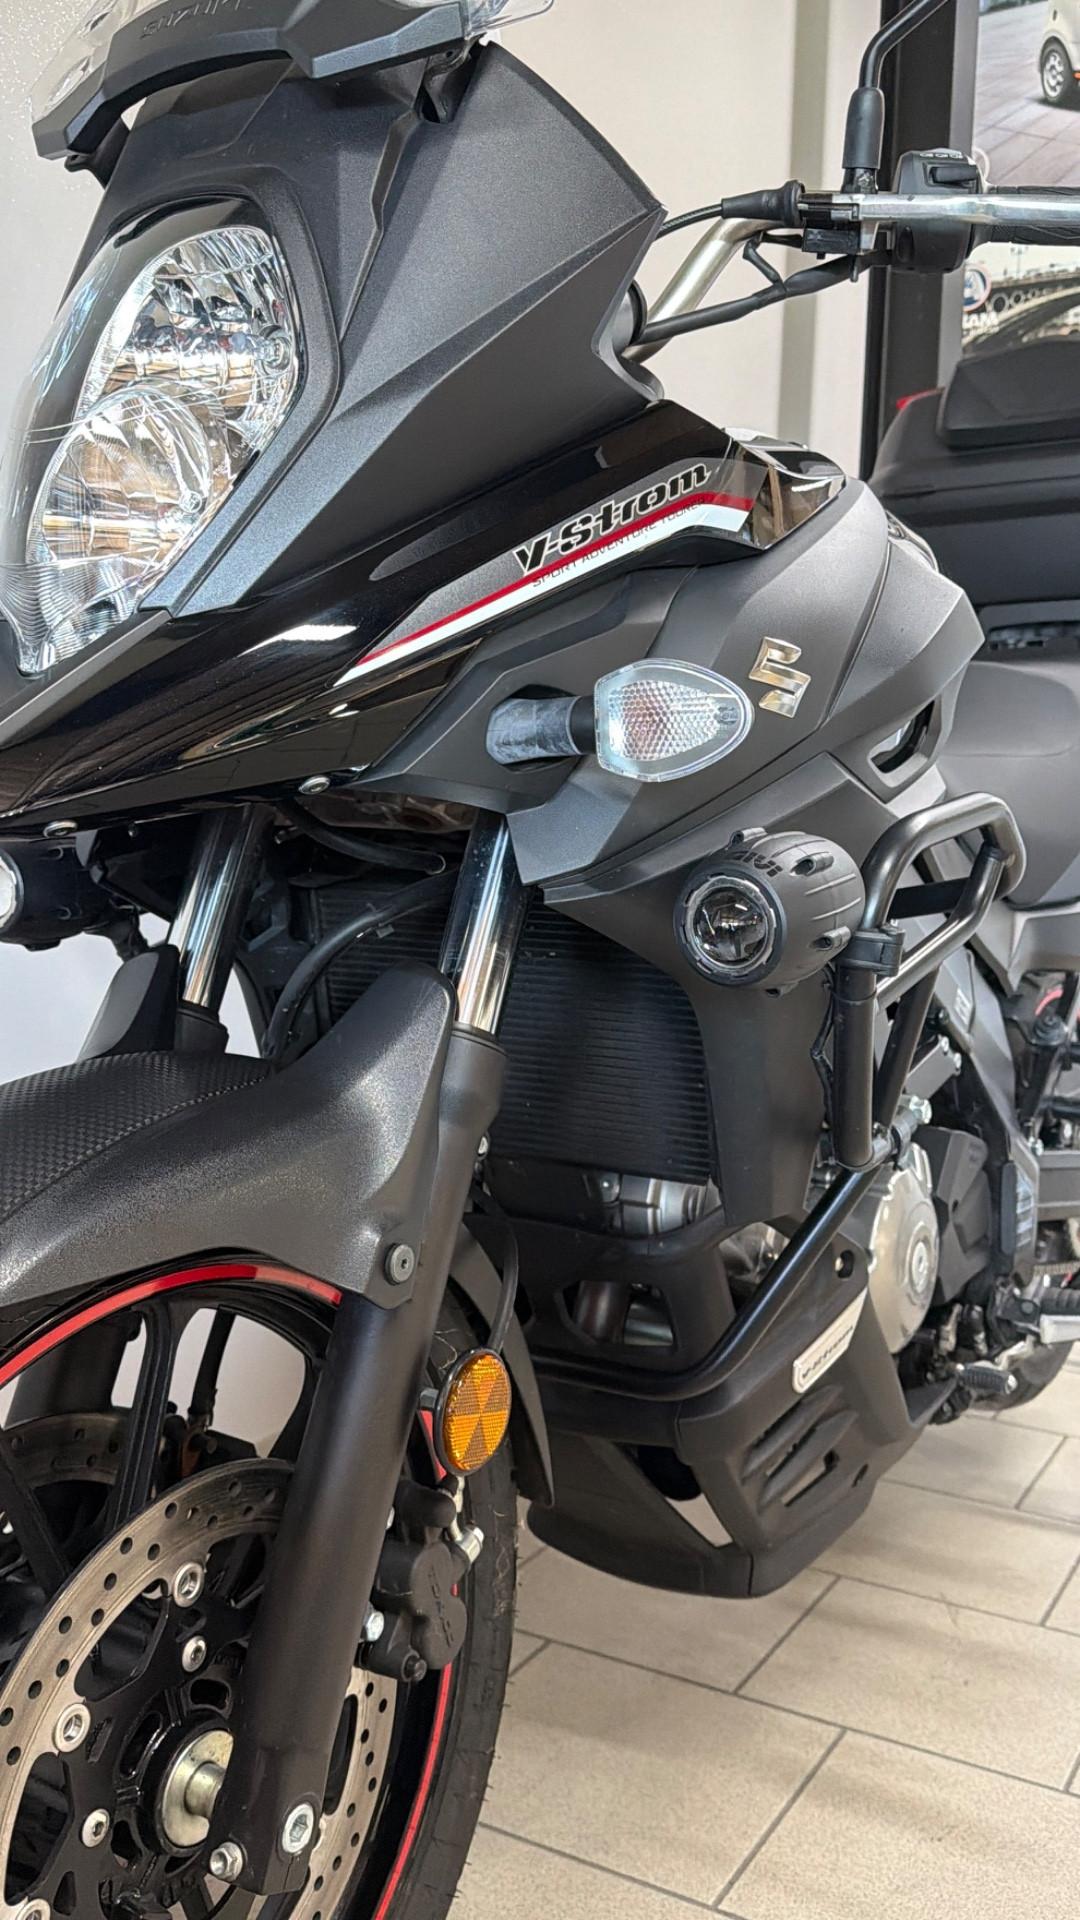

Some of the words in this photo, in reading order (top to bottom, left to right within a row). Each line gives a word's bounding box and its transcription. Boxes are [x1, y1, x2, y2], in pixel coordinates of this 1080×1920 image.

[514, 463, 712, 574] V-Strom
[532, 561, 576, 588] SPORT
[582, 523, 658, 563] ADVENTURE
